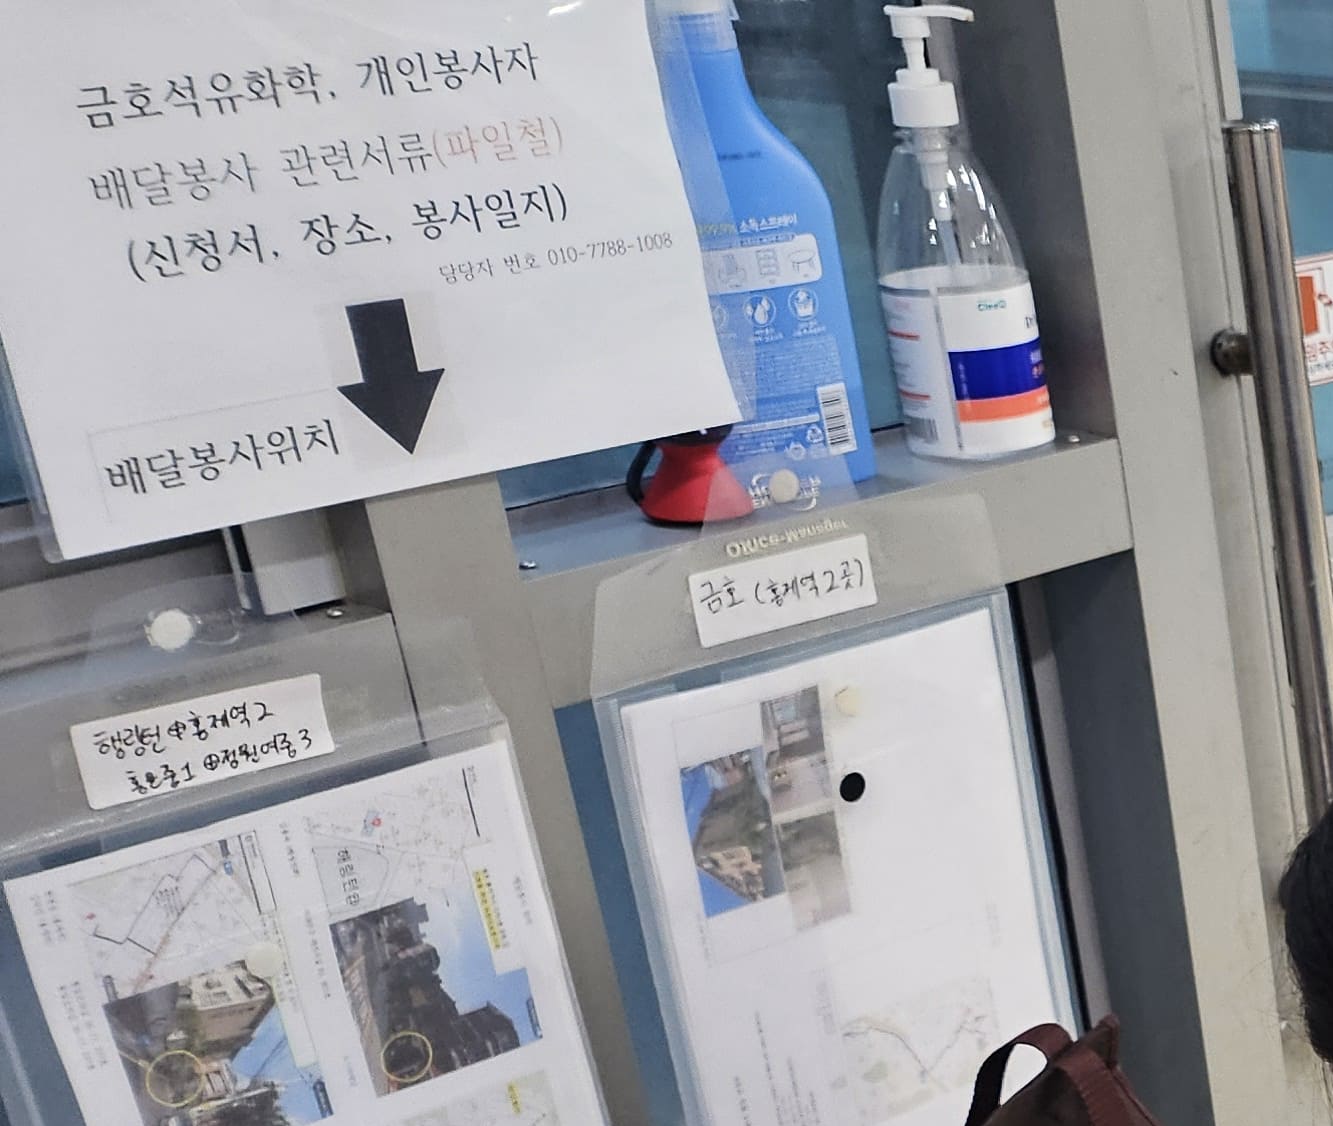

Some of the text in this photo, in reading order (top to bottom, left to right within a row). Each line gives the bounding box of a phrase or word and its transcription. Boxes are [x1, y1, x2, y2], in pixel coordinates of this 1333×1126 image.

[356, 42, 539, 100] 개인봉사자
[89, 116, 564, 212] 배달봉사 관련서류(파일철)
[126, 183, 568, 283] (신청서, 장소, 봉사일지)
[439, 232, 673, 285] 담당자 번호 010-7788-1008
[104, 419, 340, 497] 배달봉사위치
[700, 577, 745, 614] 금호
